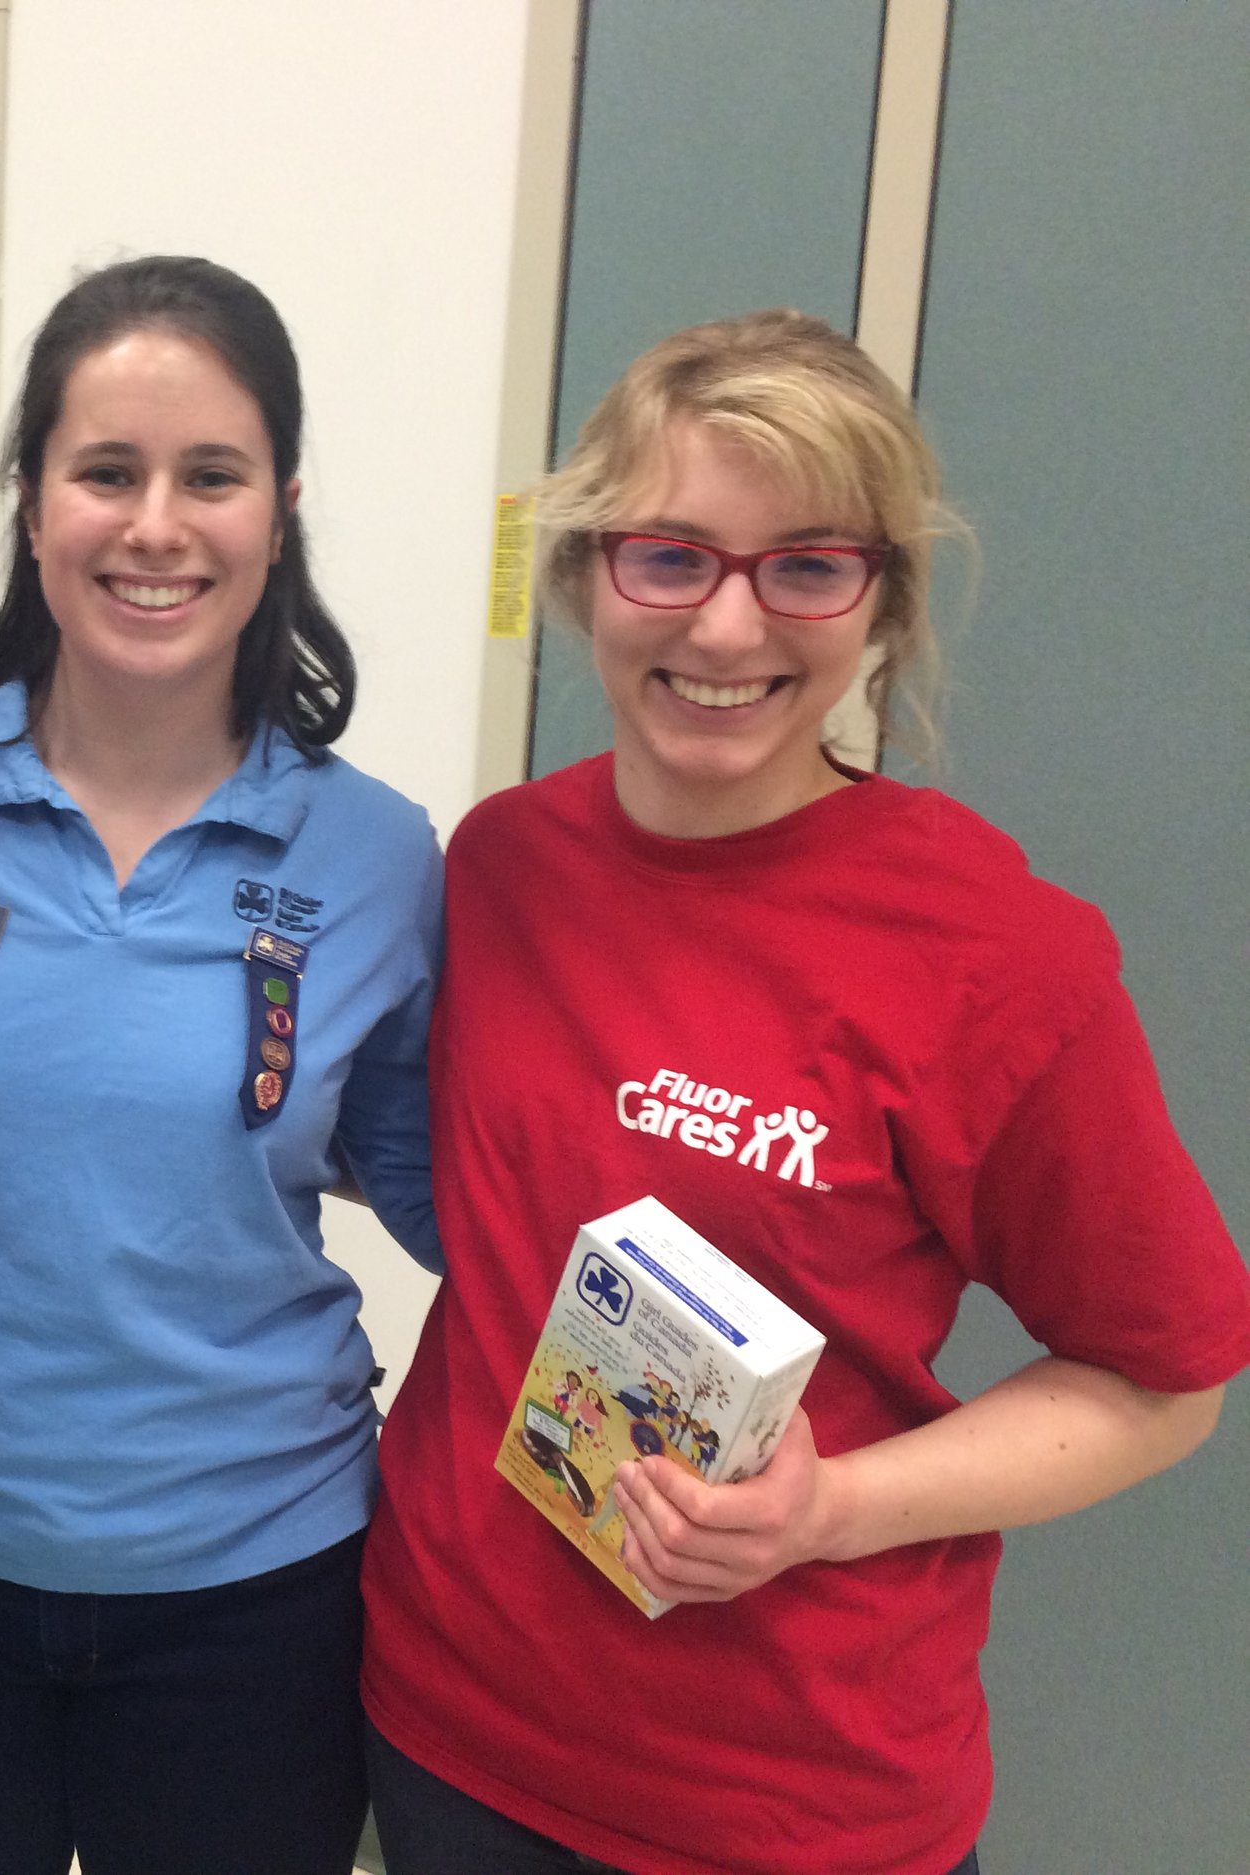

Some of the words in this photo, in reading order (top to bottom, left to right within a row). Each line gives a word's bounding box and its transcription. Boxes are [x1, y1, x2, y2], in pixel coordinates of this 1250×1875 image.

[647, 1068, 753, 1119] Fluor
[615, 1080, 742, 1158] Cares
[633, 1321, 669, 1356] Guides
[651, 1318, 692, 1359] Canada
[662, 1316, 699, 1351] Guides
[645, 1343, 686, 1384] Canada
